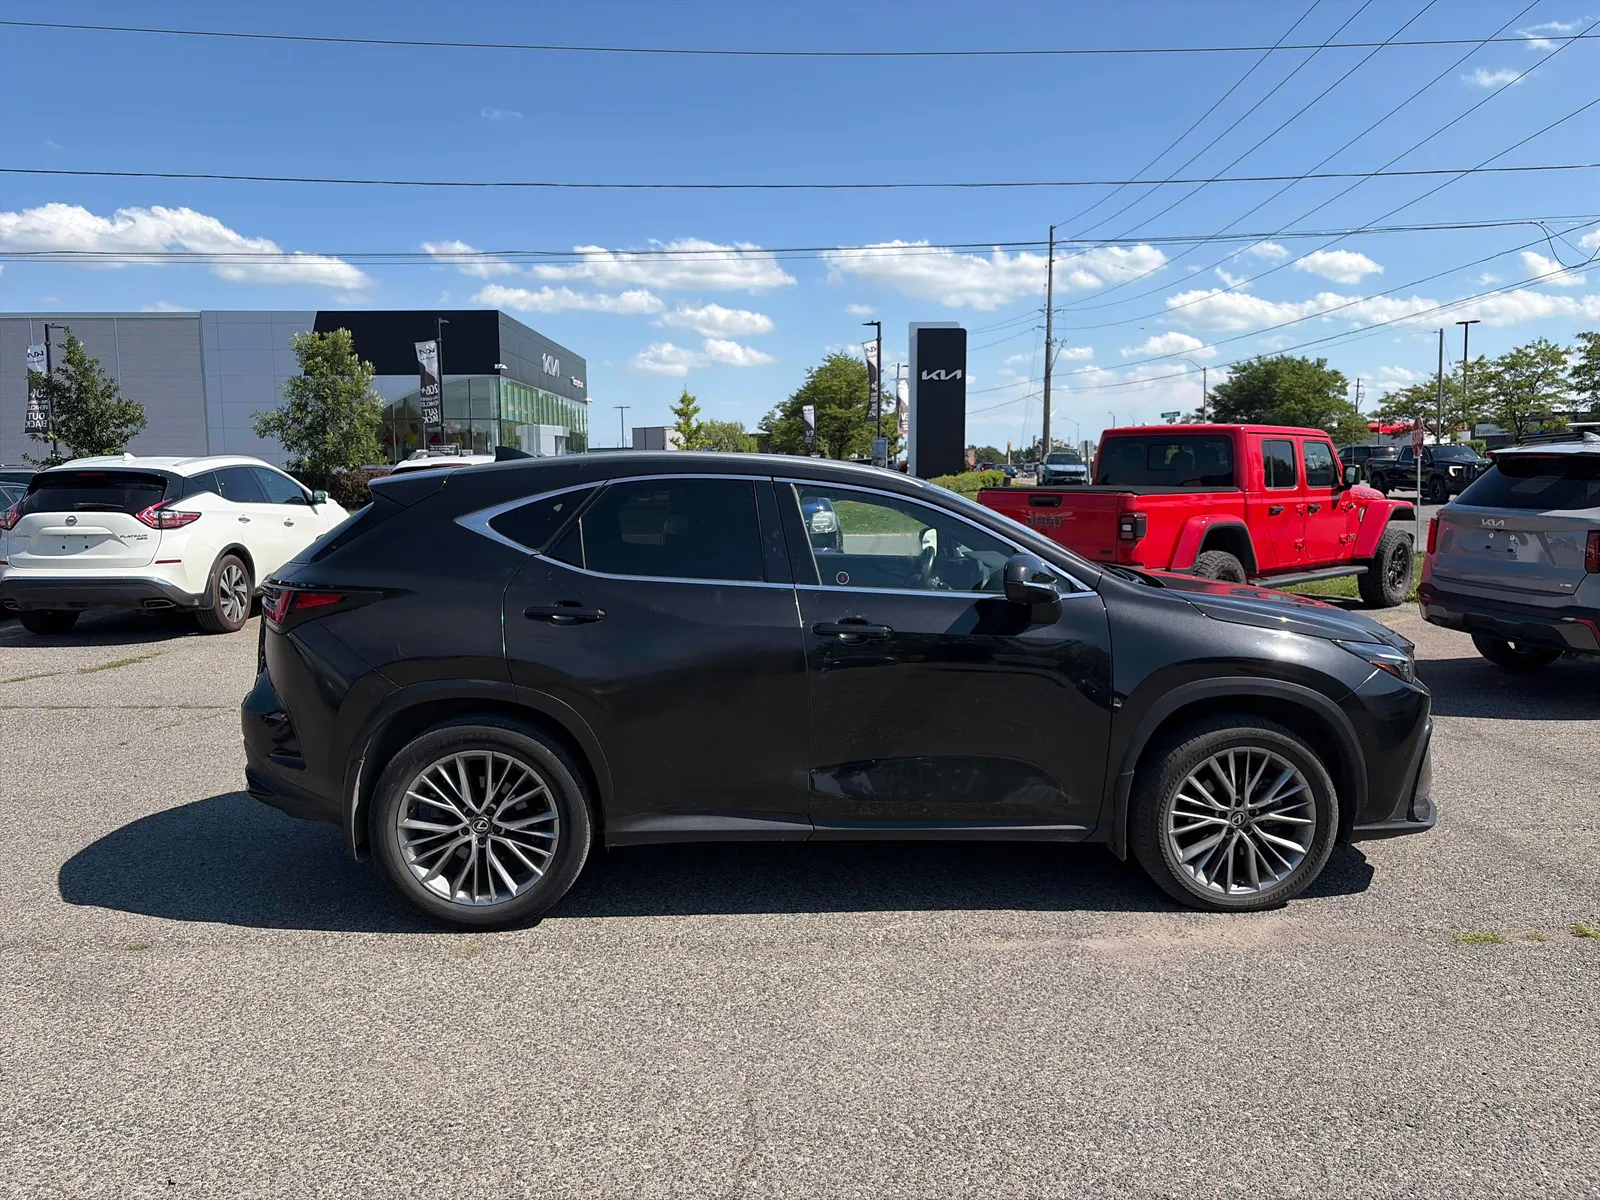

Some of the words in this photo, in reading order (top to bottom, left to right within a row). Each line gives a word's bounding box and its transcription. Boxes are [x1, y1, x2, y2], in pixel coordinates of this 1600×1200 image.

[542, 352, 560, 378] KIA
[921, 369, 962, 380] KIA
[1025, 511, 1063, 530] Jeep
[1481, 518, 1505, 526] KIA
